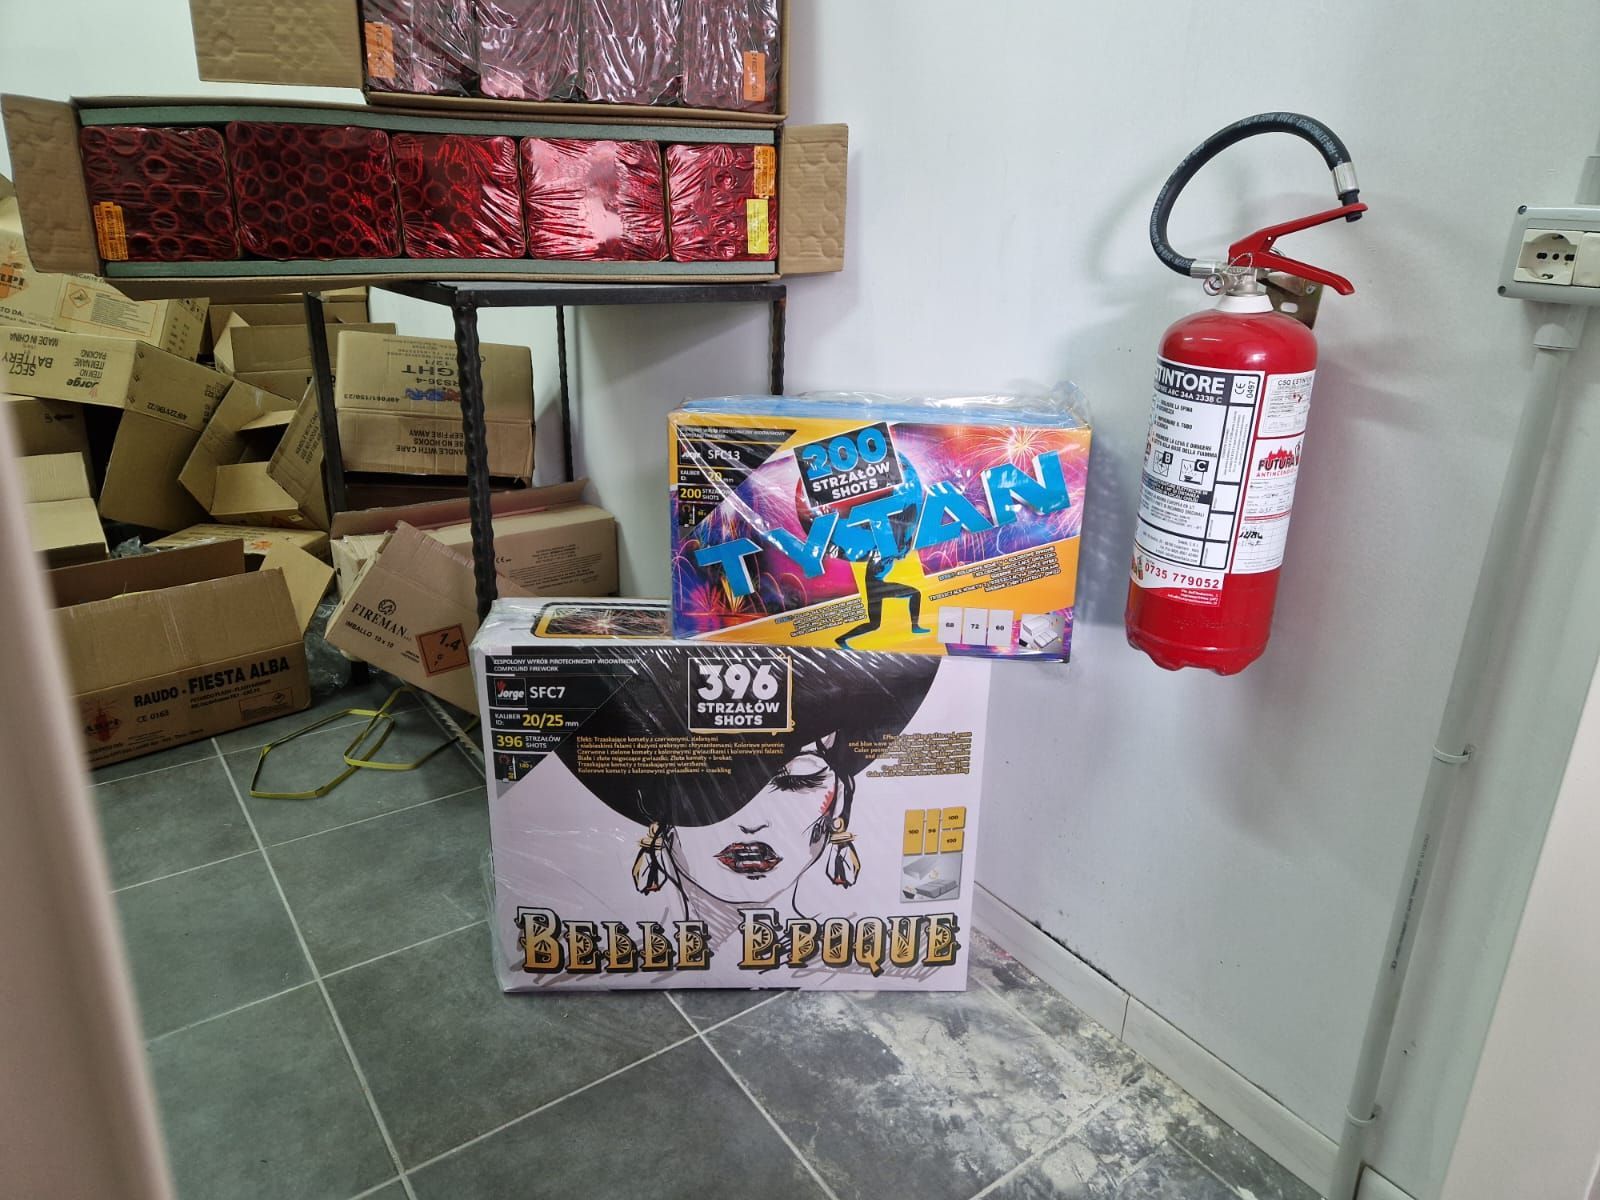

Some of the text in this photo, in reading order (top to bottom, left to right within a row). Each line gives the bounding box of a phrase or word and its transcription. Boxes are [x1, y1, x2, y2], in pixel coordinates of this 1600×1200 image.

[9, 333, 59, 347] MADE IN CHINA
[1, 351, 53, 368] BATTERY
[9, 363, 36, 376] SFC7
[400, 364, 456, 377] GHT
[408, 429, 430, 437] AWAY
[431, 430, 448, 438] FIRE
[413, 437, 441, 446] HOOKS
[395, 444, 464, 455] ANDLE WITH CARE
[802, 427, 888, 480] 200
[1164, 453, 1172, 463] B
[1197, 461, 1207, 472] C
[812, 461, 891, 492] STRZAŁÓW
[680, 487, 702, 499] 200
[832, 477, 879, 500] SHOTS
[694, 449, 1072, 598] TYTAN
[1144, 563, 1220, 589] 0735 779052
[350, 602, 407, 639] FIREMAN
[345, 620, 373, 640] IMBALLO
[438, 632, 462, 651] 1.4
[133, 686, 179, 708] RAUDO
[188, 667, 246, 695] FIESTA
[249, 656, 290, 680] ALBA
[697, 663, 779, 701] 396
[529, 686, 566, 699] SFC7
[697, 700, 780, 714] STRZAŁÓW
[522, 712, 564, 728] 20/25
[714, 714, 763, 726] SHOTS
[496, 735, 523, 748] 396
[525, 734, 561, 742] STRZAŁÓW
[516, 905, 961, 978] BELLE EPOQUE
